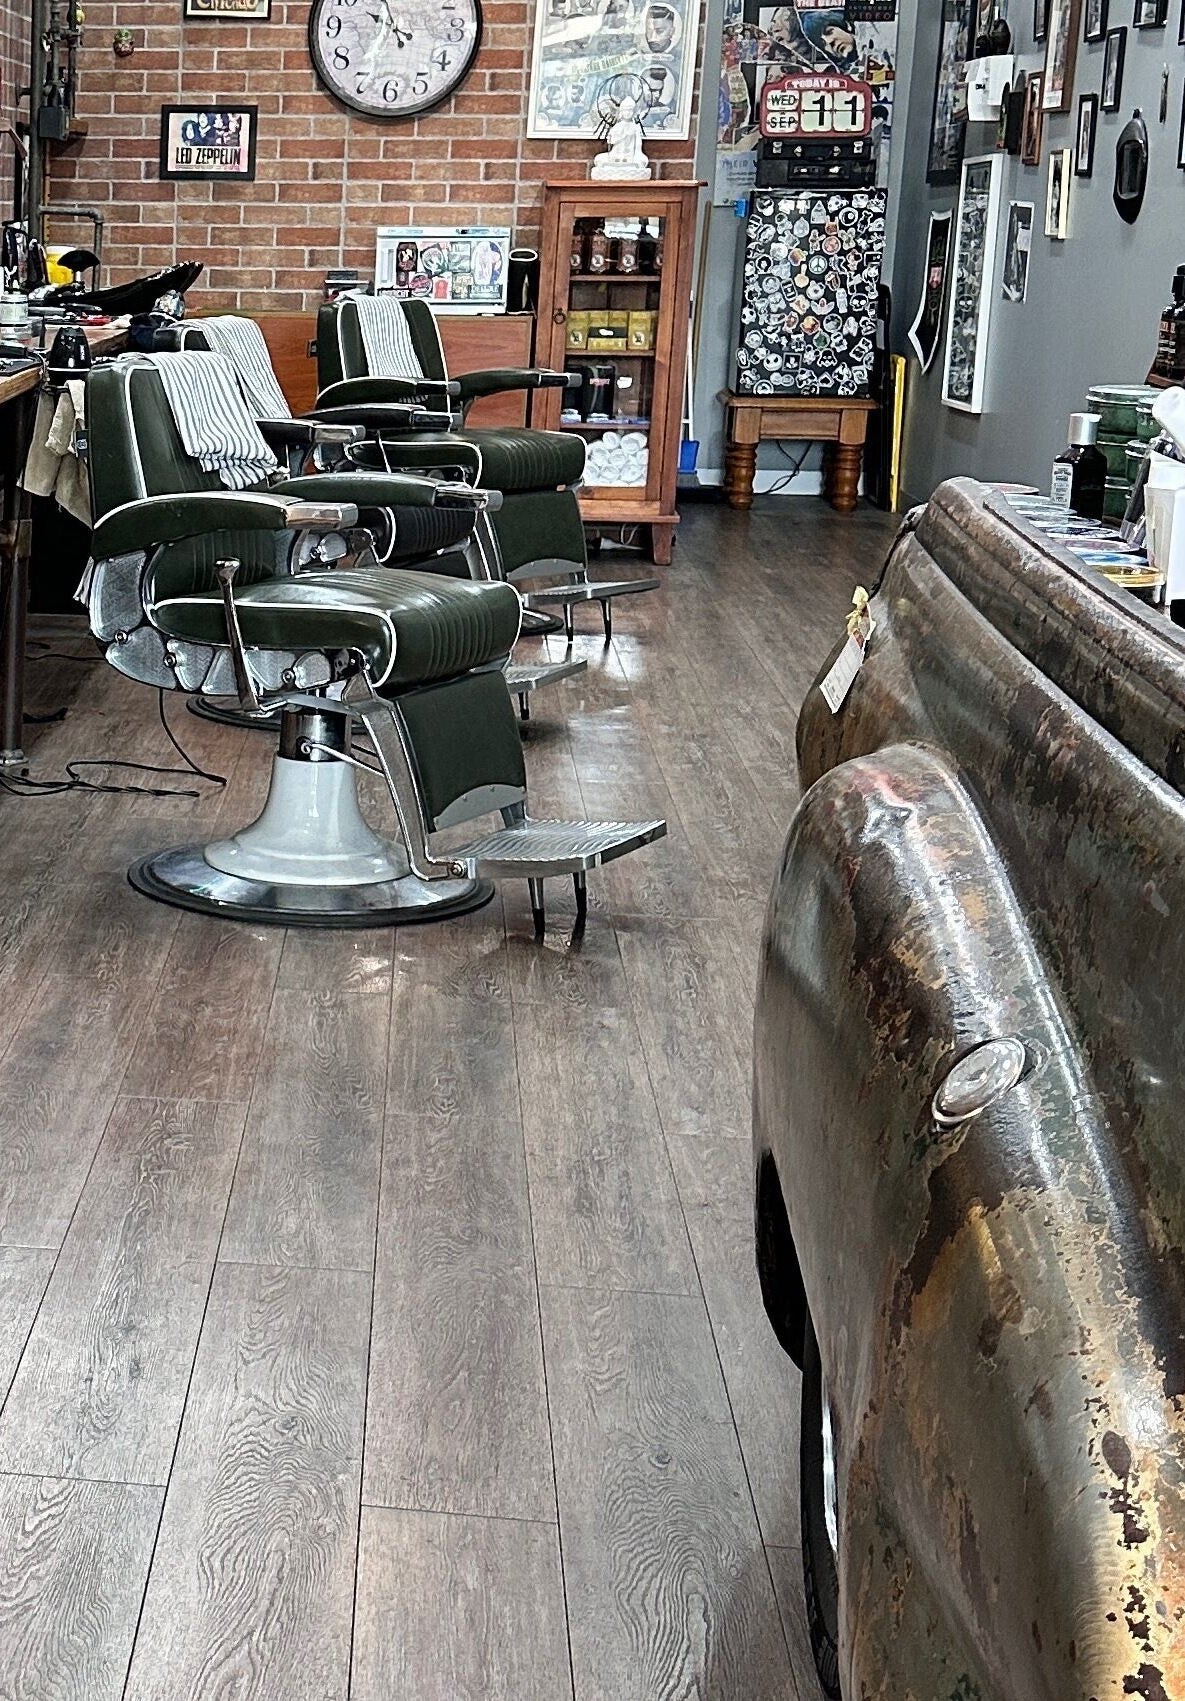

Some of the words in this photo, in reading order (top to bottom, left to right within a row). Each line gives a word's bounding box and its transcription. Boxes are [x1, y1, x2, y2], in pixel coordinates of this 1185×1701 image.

[326, 15, 342, 39] 9
[447, 17, 465, 42] 3
[333, 46, 350, 70] 8
[432, 49, 452, 71] 4
[355, 72, 371, 95] 7
[383, 79, 399, 103] 6
[413, 72, 429, 95] 5
[770, 94, 796, 106] WED
[770, 116, 796, 128] SEP
[176, 147, 192, 164] LED
[196, 147, 241, 165] ZEPPELIN
